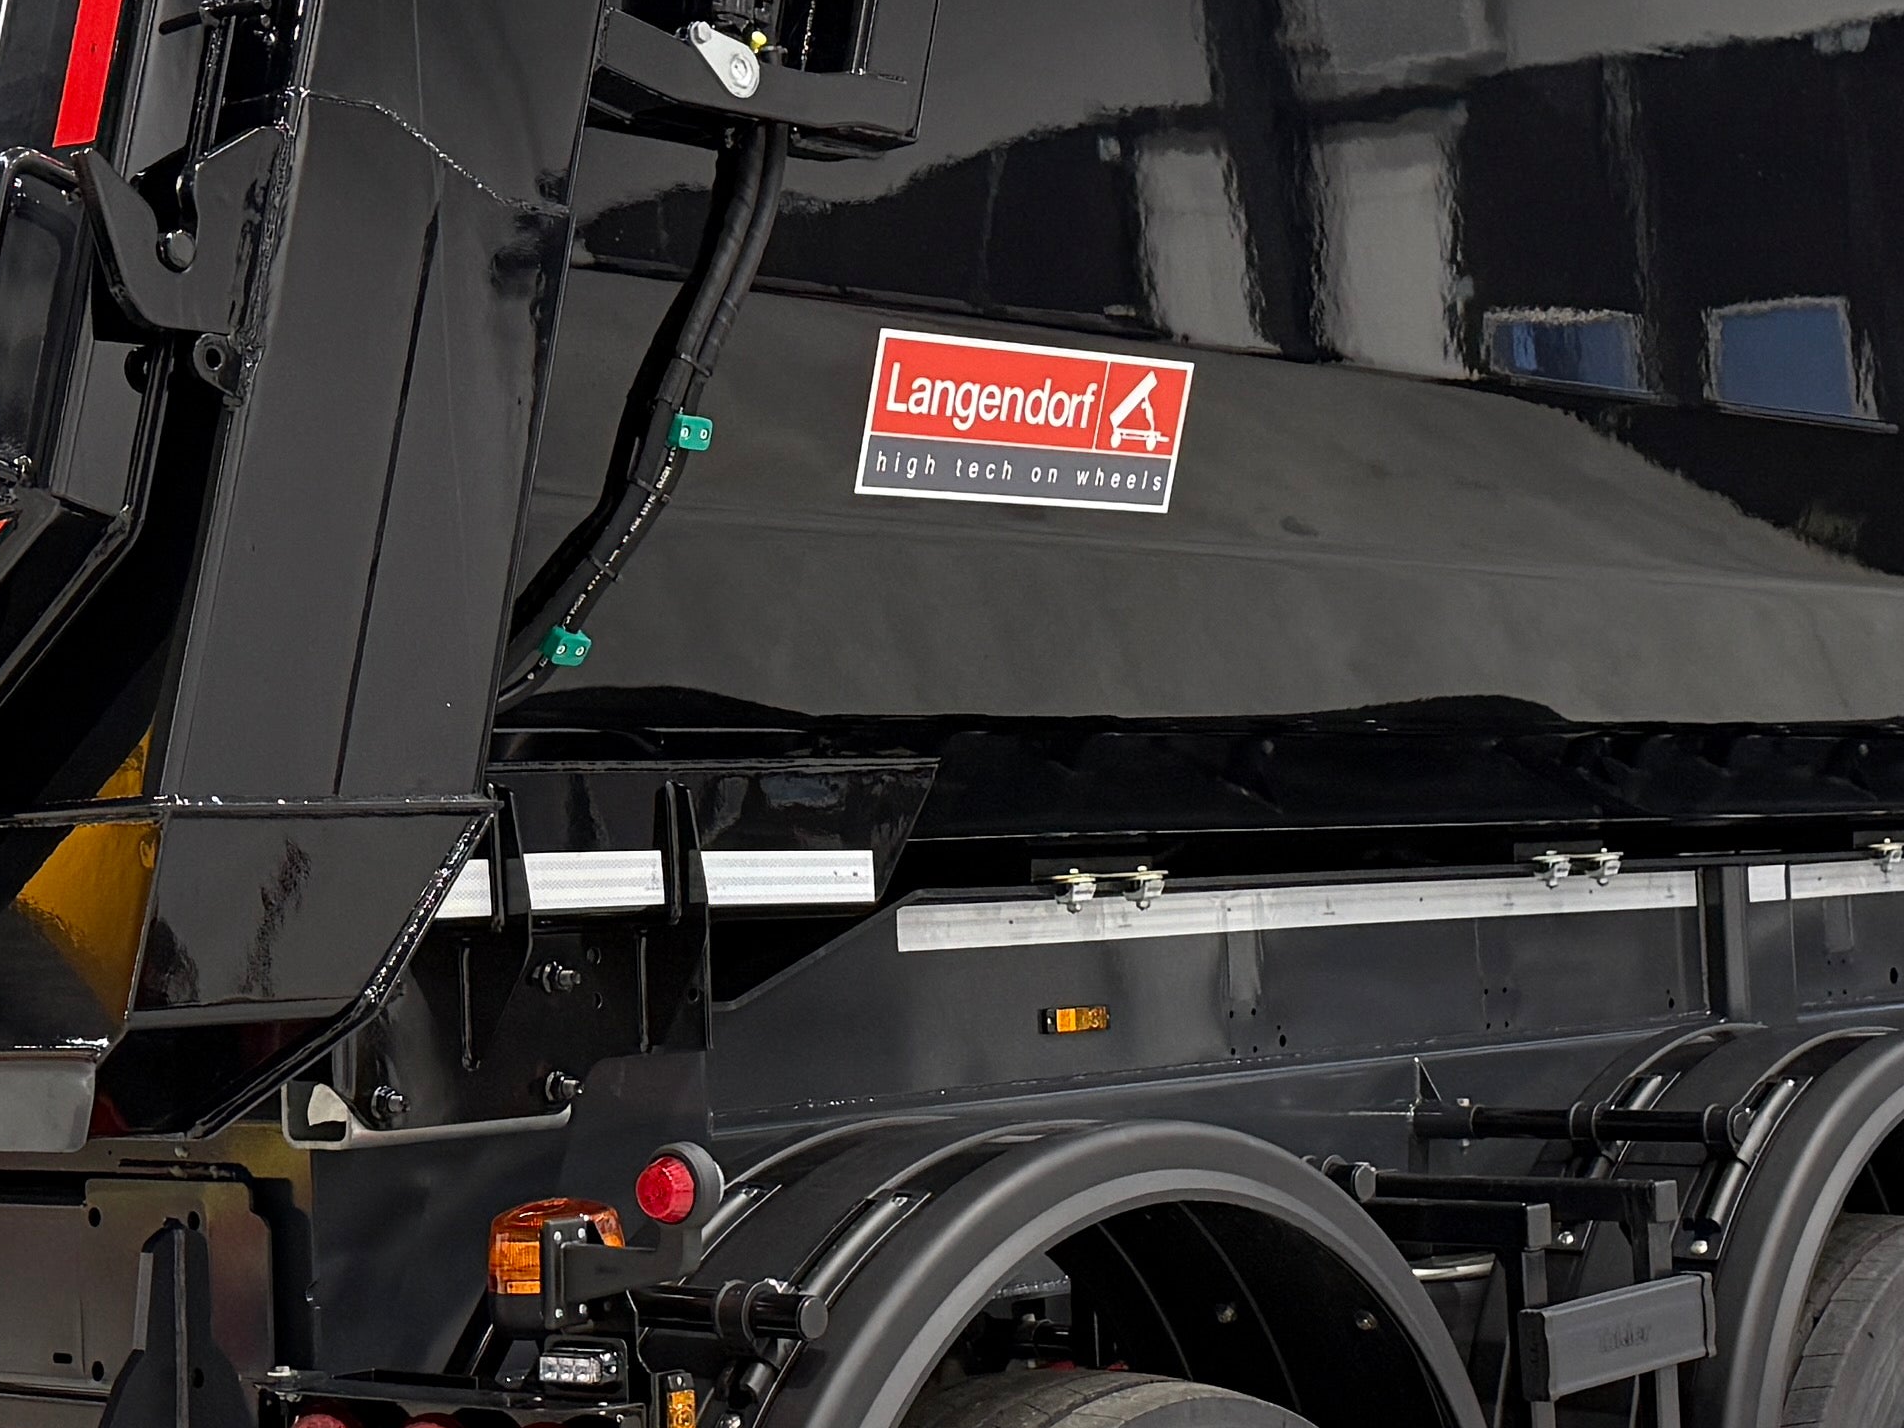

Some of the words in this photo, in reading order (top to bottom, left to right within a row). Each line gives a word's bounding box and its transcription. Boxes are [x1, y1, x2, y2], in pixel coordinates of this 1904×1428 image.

[886, 361, 1098, 431] Langendorf
[876, 450, 937, 479] high
[956, 457, 1013, 481] tech
[1031, 466, 1059, 484] on
[1076, 467, 1163, 492] wheels
